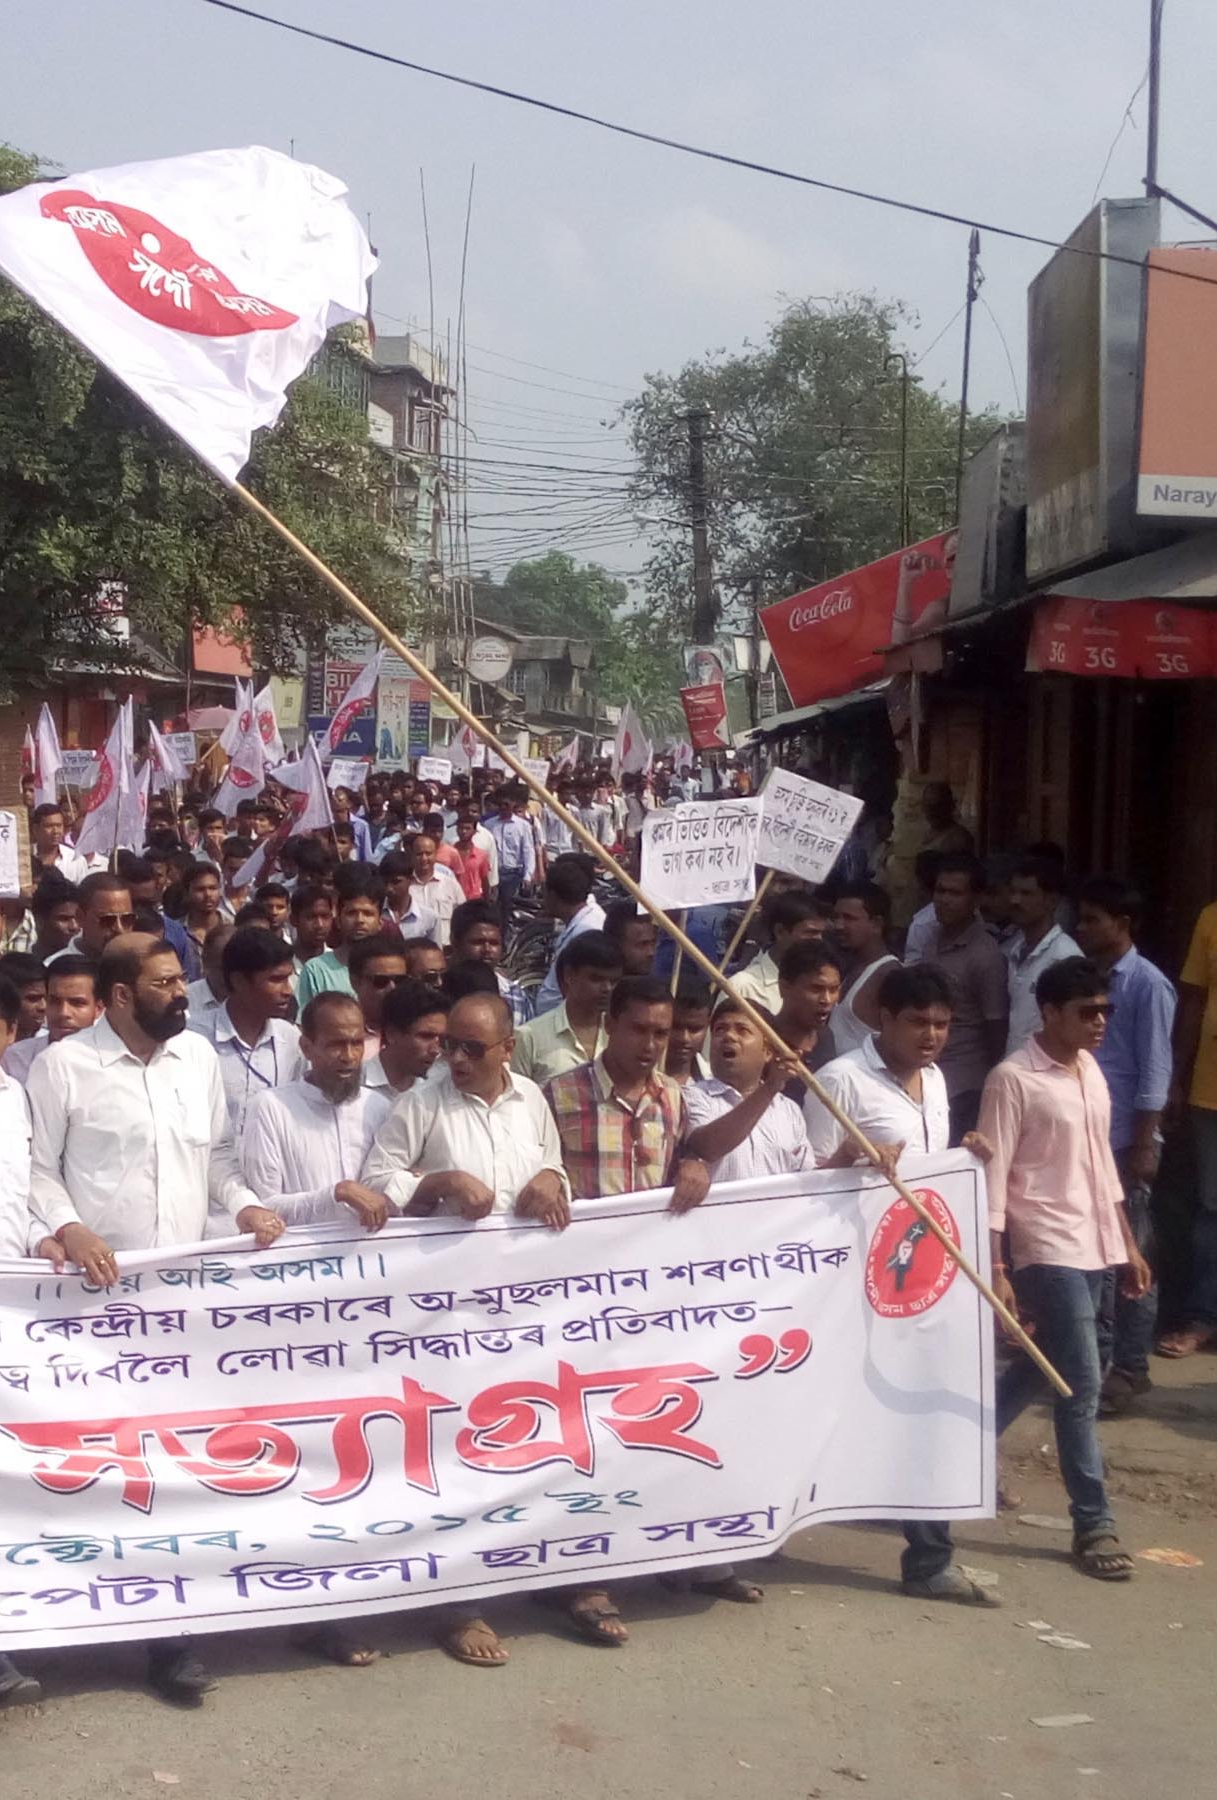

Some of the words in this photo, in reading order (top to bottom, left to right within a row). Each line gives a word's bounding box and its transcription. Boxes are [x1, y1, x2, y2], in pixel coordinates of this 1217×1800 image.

[1154, 484, 1217, 508] Naray
[1085, 646, 1116, 669] 3G
[1157, 653, 1190, 673] 3G
[156, 1258, 239, 1291] আই
[204, 1295, 393, 1331] চৰকাৰে
[216, 1339, 348, 1376] লোৱা
[308, 1501, 531, 1543] ২০১৫
[543, 1488, 643, 1520] ইং
[224, 1550, 442, 1603] জিলা
[639, 1505, 782, 1548] সন্থা
